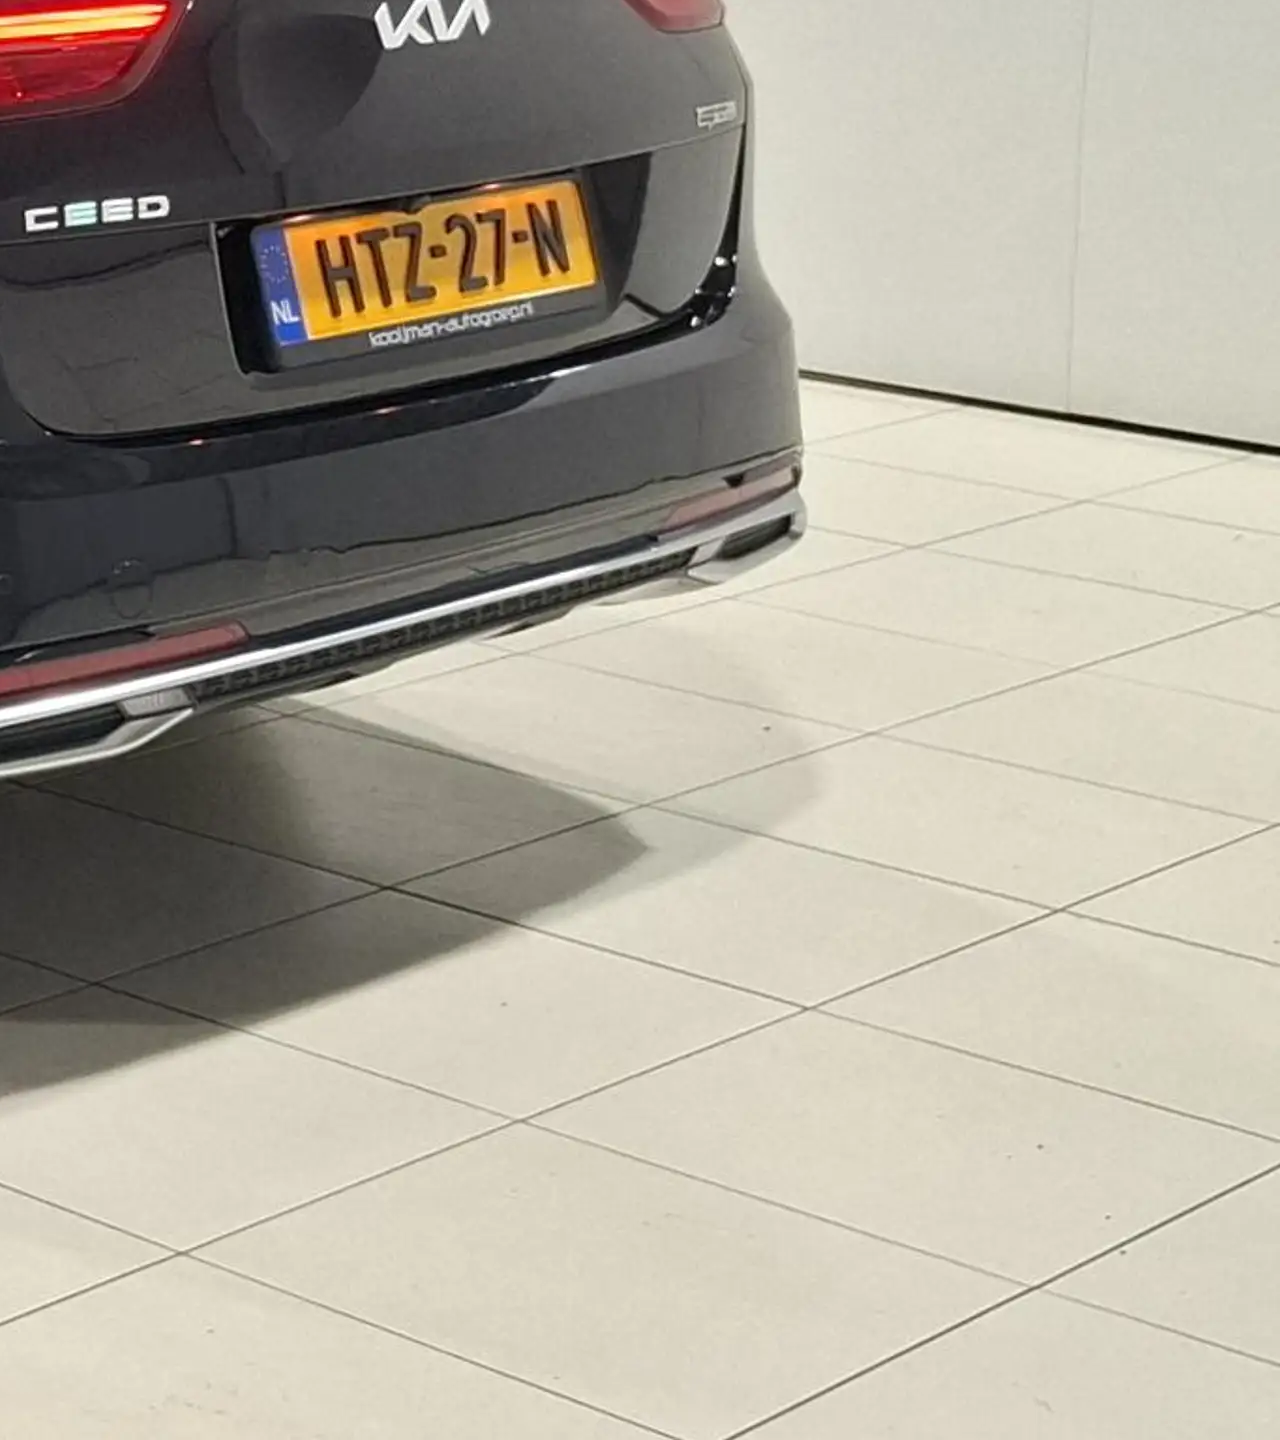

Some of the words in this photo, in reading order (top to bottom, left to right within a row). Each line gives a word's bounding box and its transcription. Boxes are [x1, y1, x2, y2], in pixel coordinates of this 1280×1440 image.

[24, 195, 171, 233] CEED
[315, 199, 572, 320] HTZ-27-N
[271, 300, 300, 326] NL
